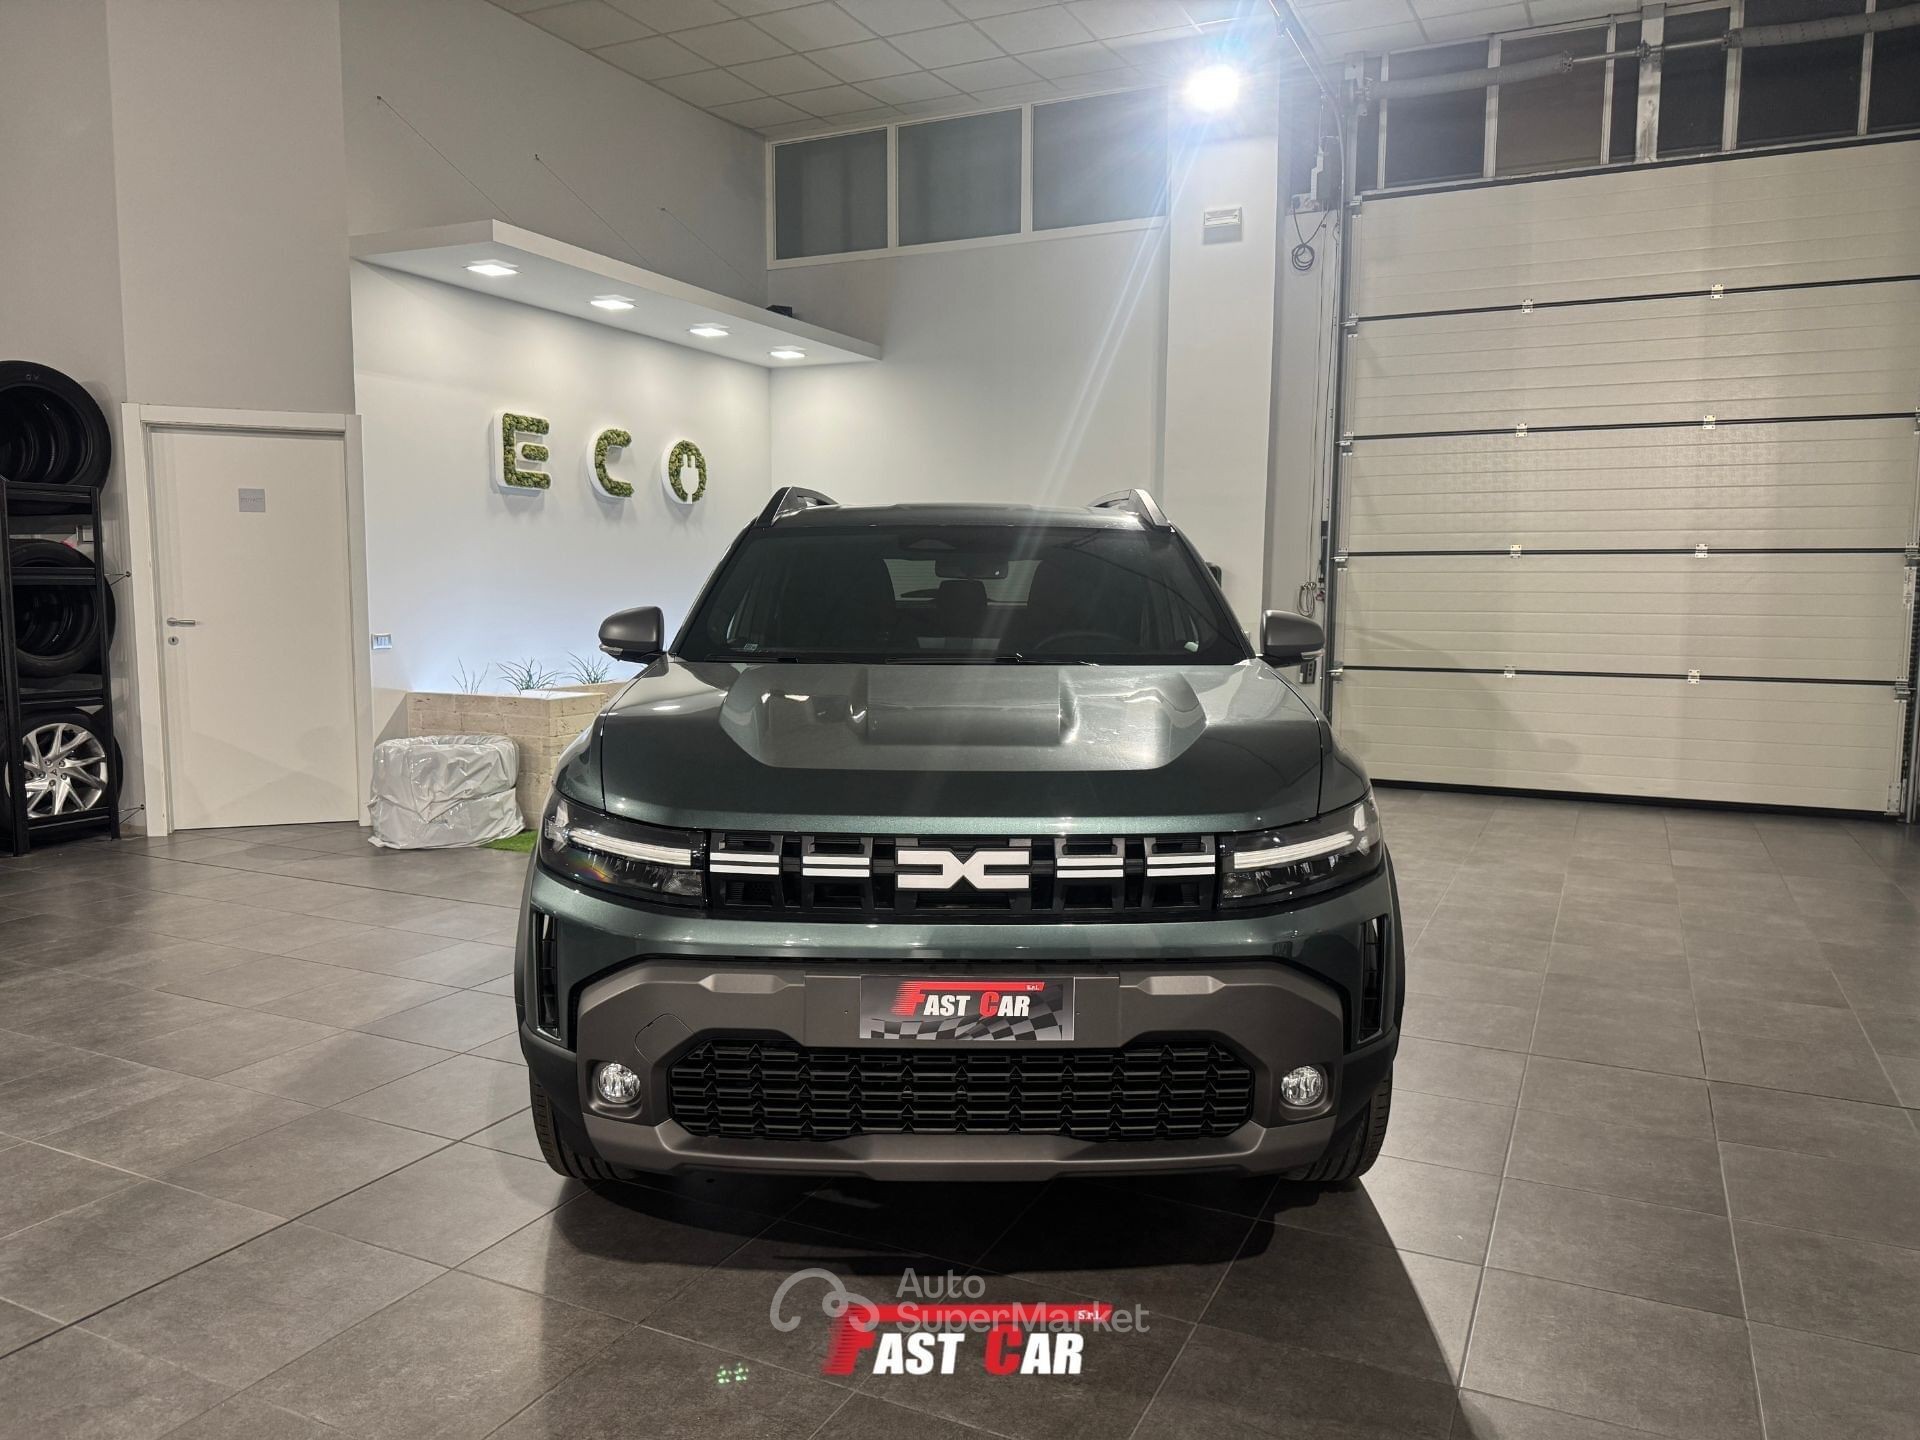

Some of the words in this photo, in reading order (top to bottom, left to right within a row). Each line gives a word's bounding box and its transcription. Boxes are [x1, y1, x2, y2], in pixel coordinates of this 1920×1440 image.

[493, 410, 707, 504] ECO
[890, 981, 971, 1017] FAST
[979, 991, 1030, 1017] CAR
